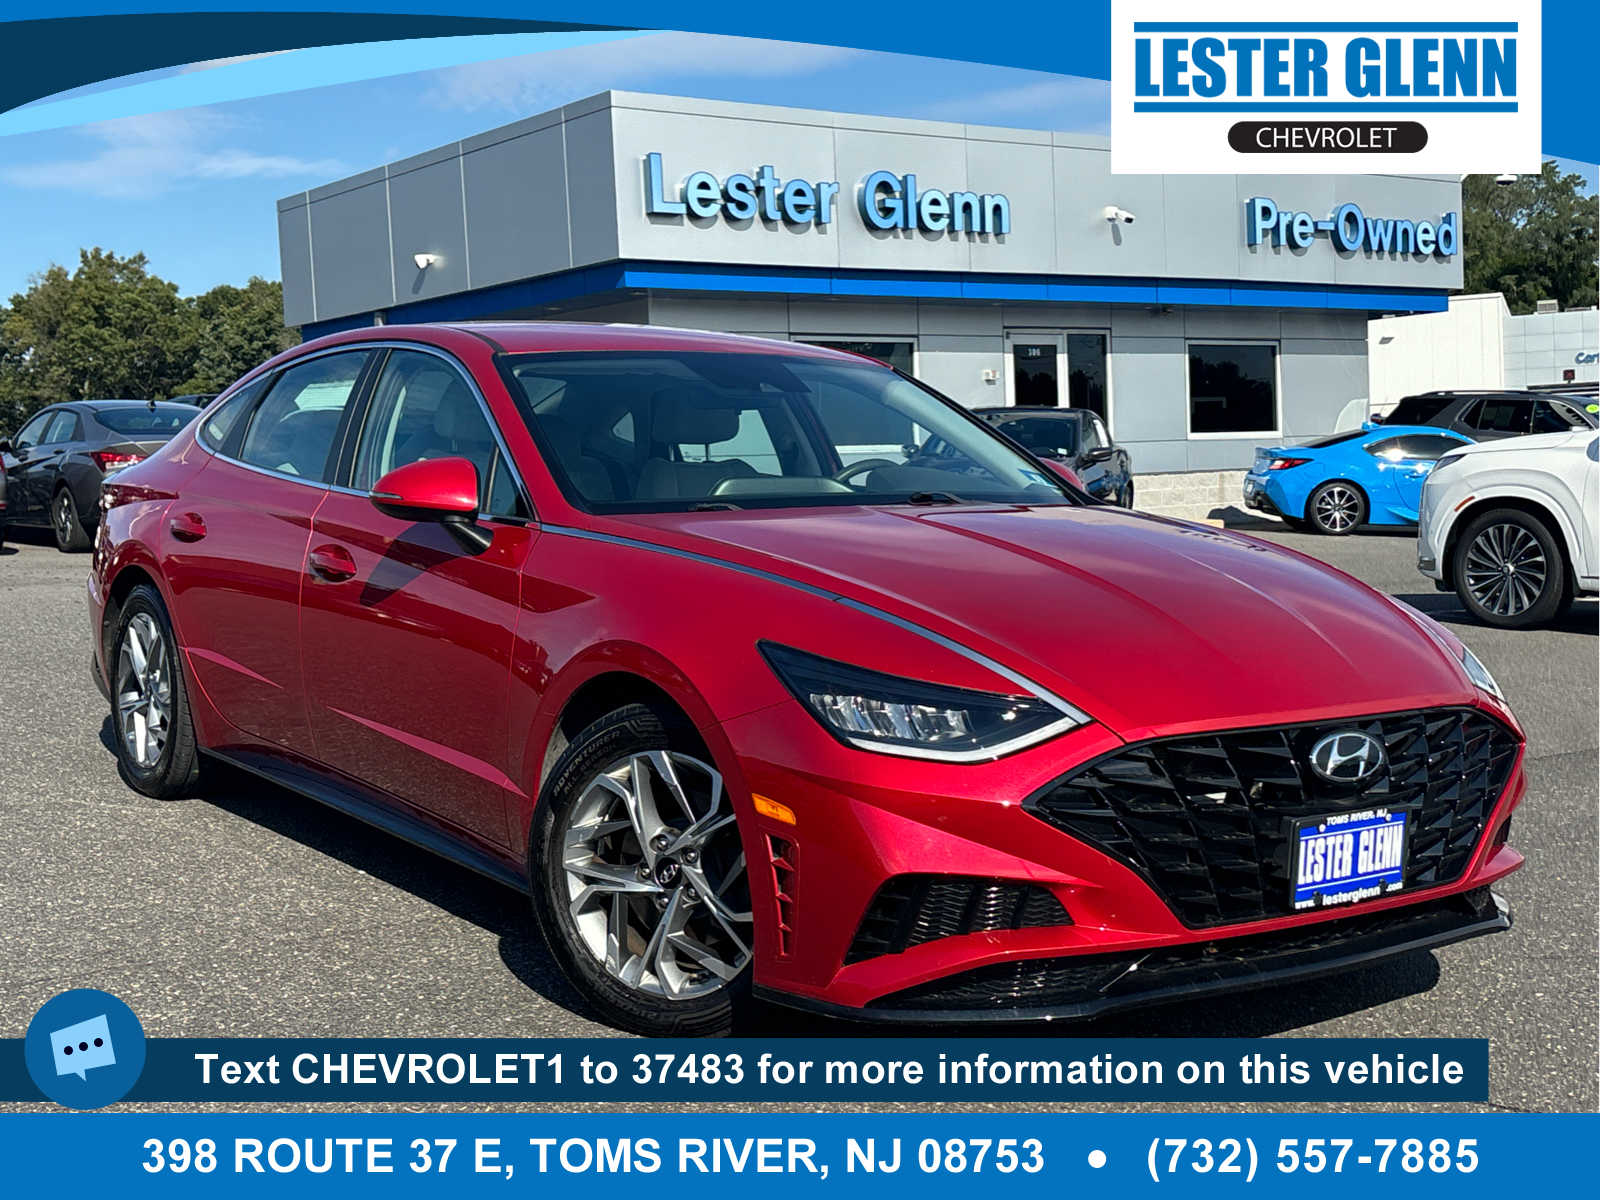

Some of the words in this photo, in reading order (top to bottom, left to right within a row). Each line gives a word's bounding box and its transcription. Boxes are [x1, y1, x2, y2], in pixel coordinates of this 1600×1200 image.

[643, 152, 839, 226] Lester
[858, 170, 1011, 235] Glenn
[1246, 197, 1458, 258] Pre-Owned
[1326, 814, 1349, 826] TOMS
[1297, 833, 1354, 885] LESTER
[1357, 824, 1403, 874] GLENN
[1322, 886, 1380, 906] lesterglenn
